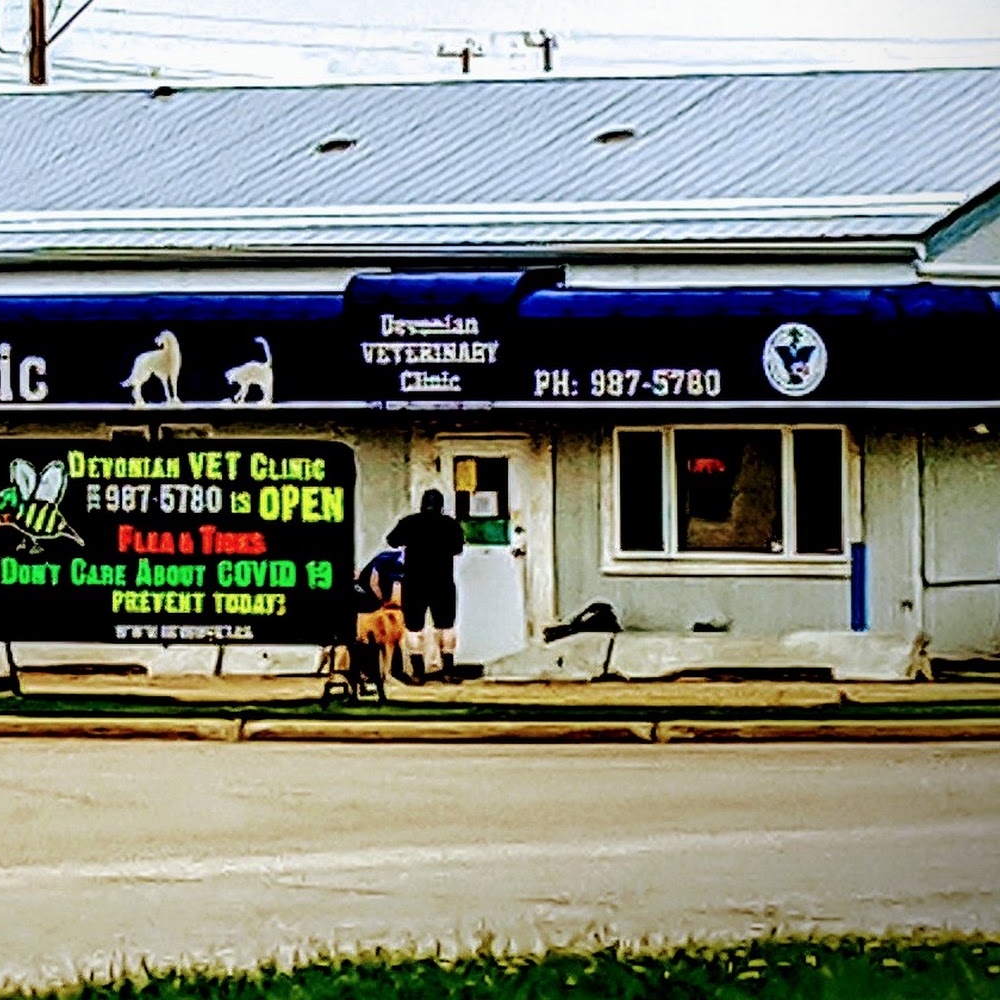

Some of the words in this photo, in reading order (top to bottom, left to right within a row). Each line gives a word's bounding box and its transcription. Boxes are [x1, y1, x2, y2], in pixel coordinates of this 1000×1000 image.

[380, 314, 479, 336] Devian
[534, 369, 578, 396] PH:
[591, 369, 720, 396] 987-5780
[188, 451, 241, 480] VET
[259, 484, 344, 522] OPEN
[218, 560, 296, 587] COVID
